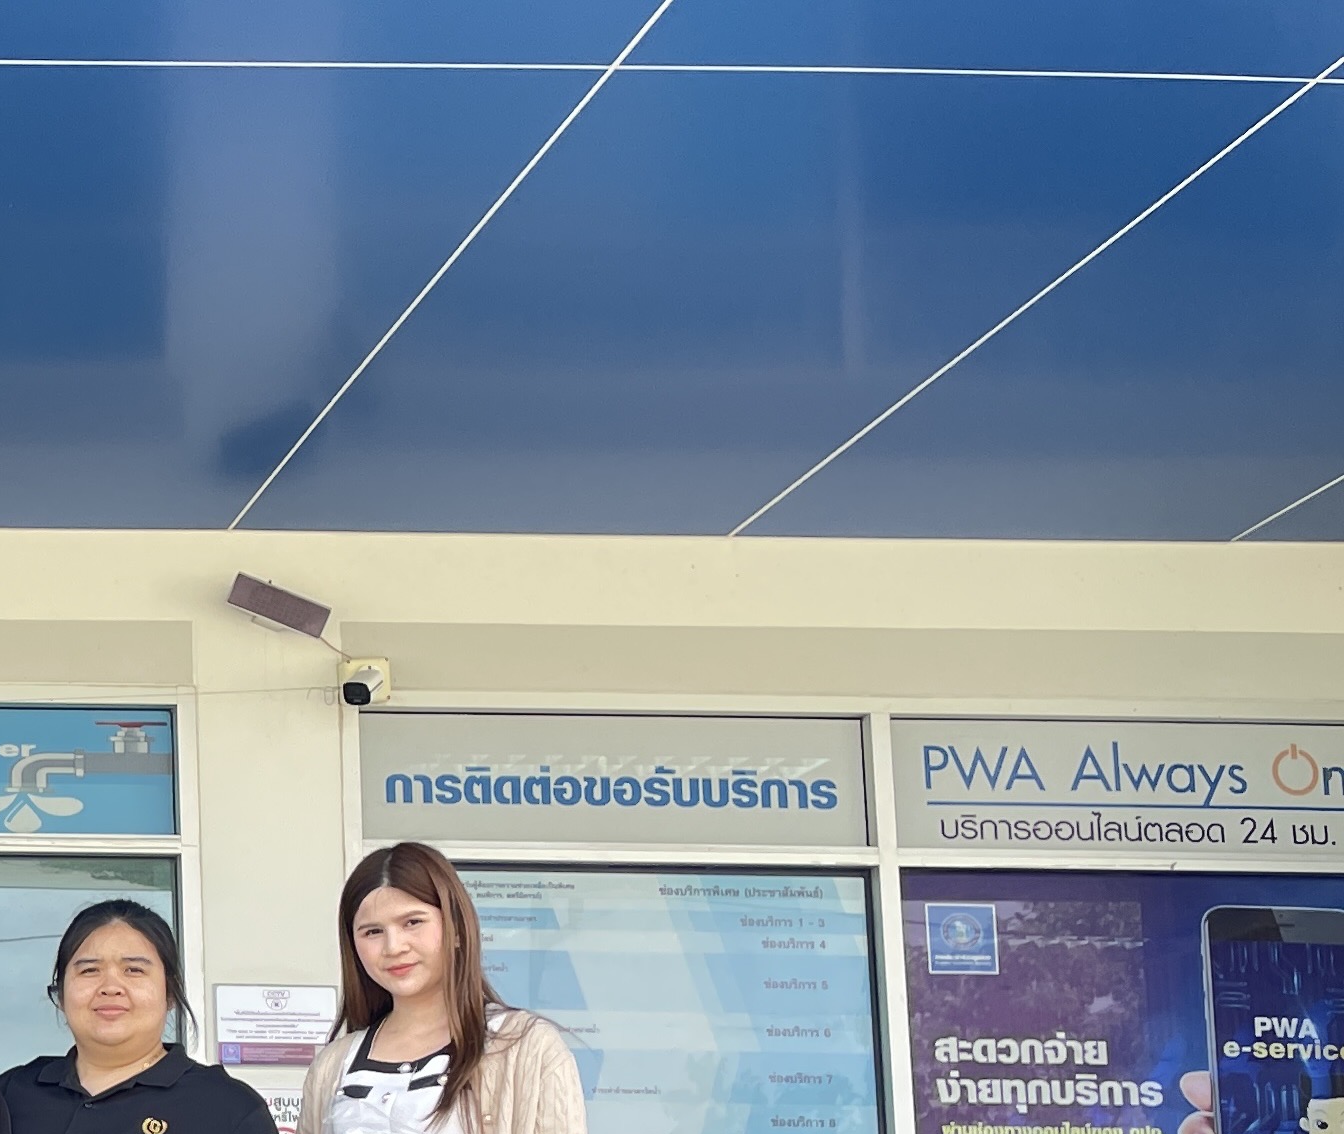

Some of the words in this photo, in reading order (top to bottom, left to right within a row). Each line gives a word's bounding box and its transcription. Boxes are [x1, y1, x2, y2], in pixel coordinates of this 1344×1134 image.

[385, 760, 839, 811] การติดต่อขอรับบริการ
[923, 744, 1038, 795] PWA
[1071, 740, 1248, 808] Always
[939, 810, 1226, 845] บริการออนไลน์ตลอด
[1240, 816, 1278, 844] 24
[1291, 824, 1336, 846] ชม.
[1253, 1016, 1319, 1040] PWA
[933, 1030, 1109, 1067] สะดวกจ่าย
[935, 1070, 1164, 1114] ง่ายทุกบริการ
